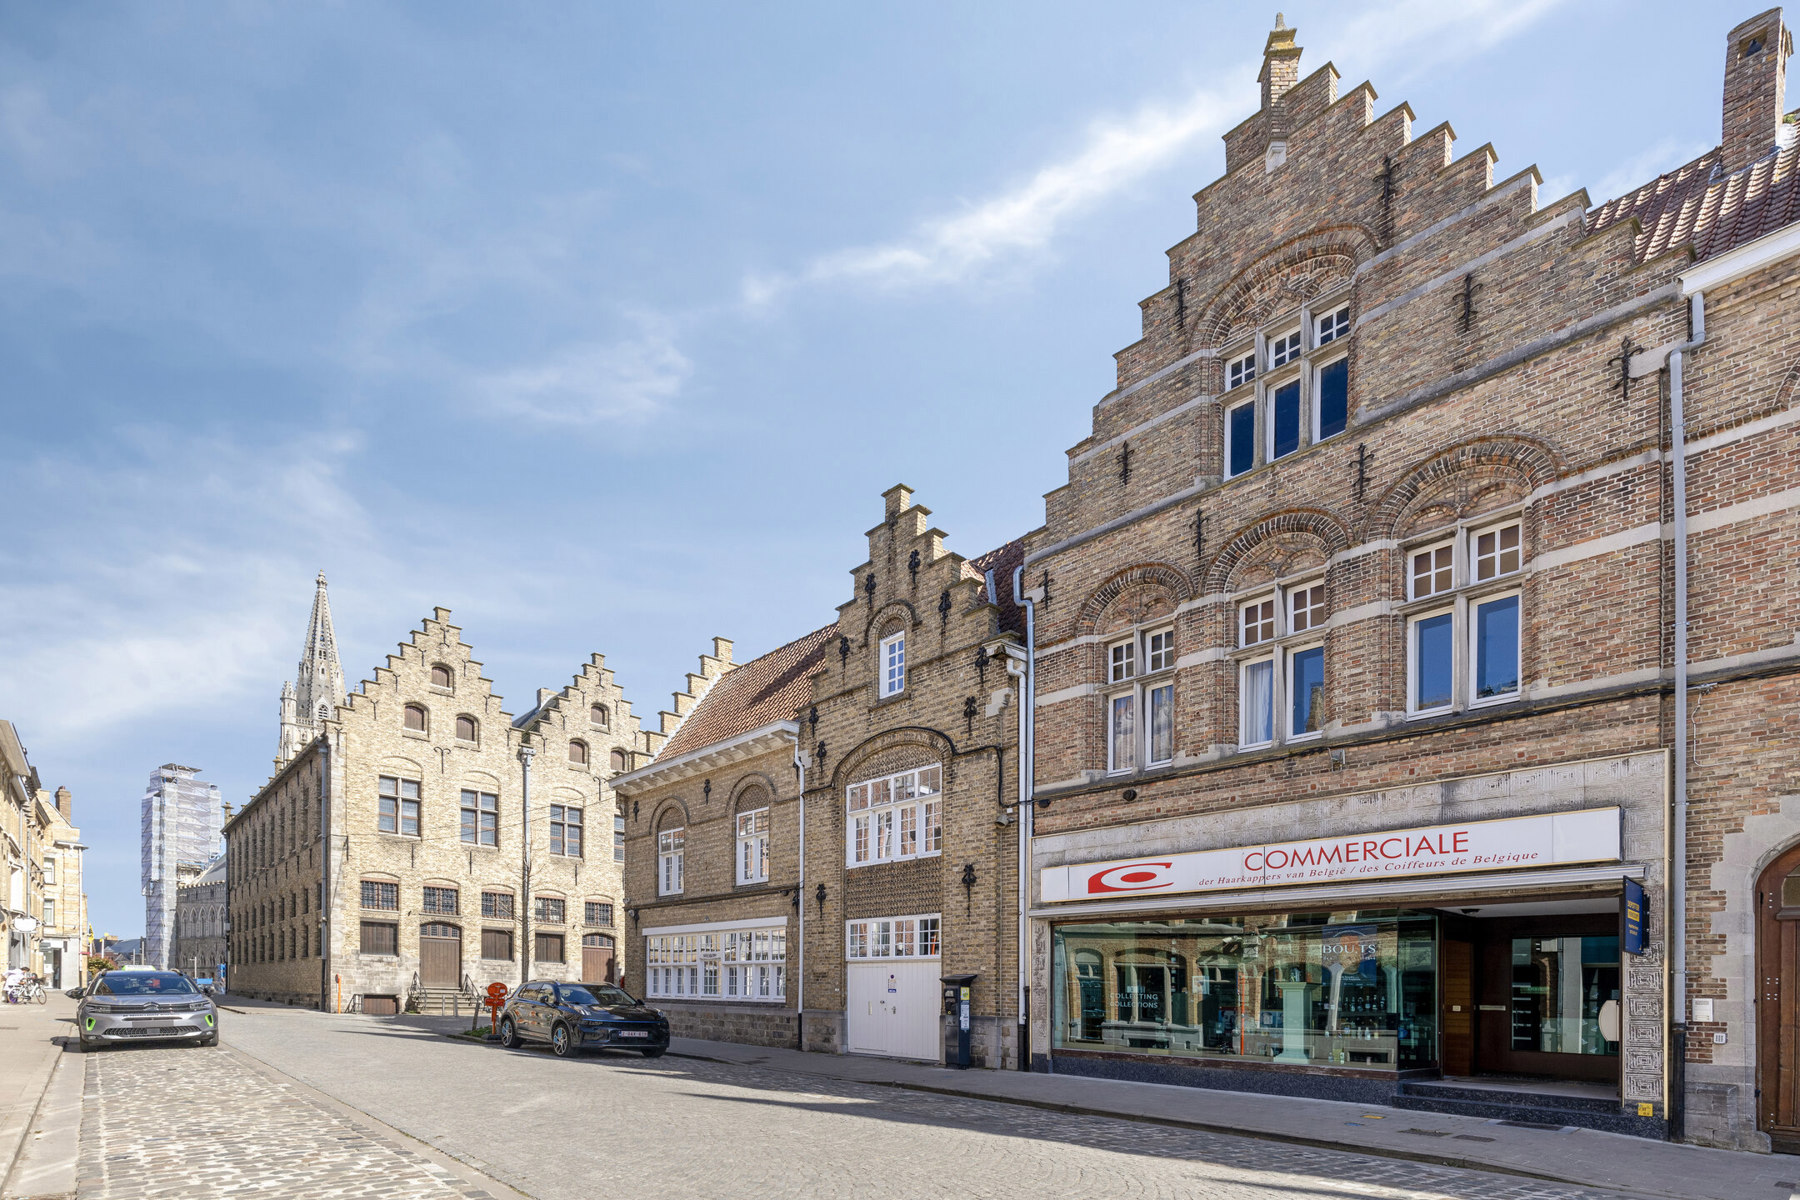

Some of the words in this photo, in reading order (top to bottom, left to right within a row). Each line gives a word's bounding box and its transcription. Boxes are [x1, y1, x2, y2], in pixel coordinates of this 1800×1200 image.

[1199, 878, 1214, 886] der
[1217, 873, 1281, 885] Haarkappers
[1309, 867, 1346, 879] België
[1359, 865, 1379, 873] des
[1384, 860, 1445, 871] Coiffeurs
[1451, 857, 1467, 866] de
[1473, 851, 1539, 865] Belgique
[1245, 831, 1468, 871] COMMERCIALE
